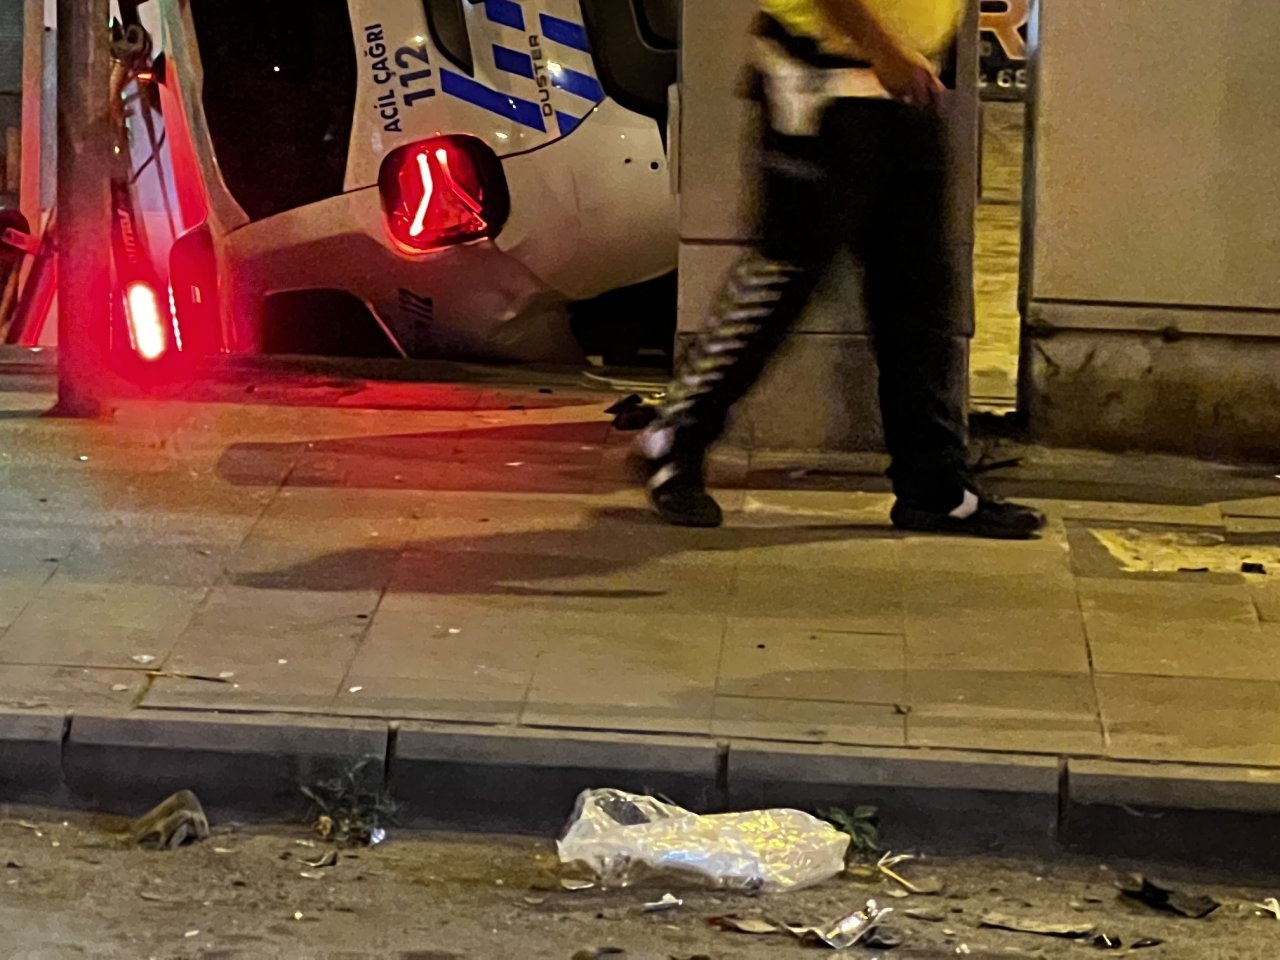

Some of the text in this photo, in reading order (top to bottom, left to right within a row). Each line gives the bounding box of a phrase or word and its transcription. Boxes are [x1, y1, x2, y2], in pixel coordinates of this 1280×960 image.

[364, 24, 402, 133] ACİL ÇAĞRI
[395, 44, 436, 107] 112
[528, 34, 553, 117] DUSTER
